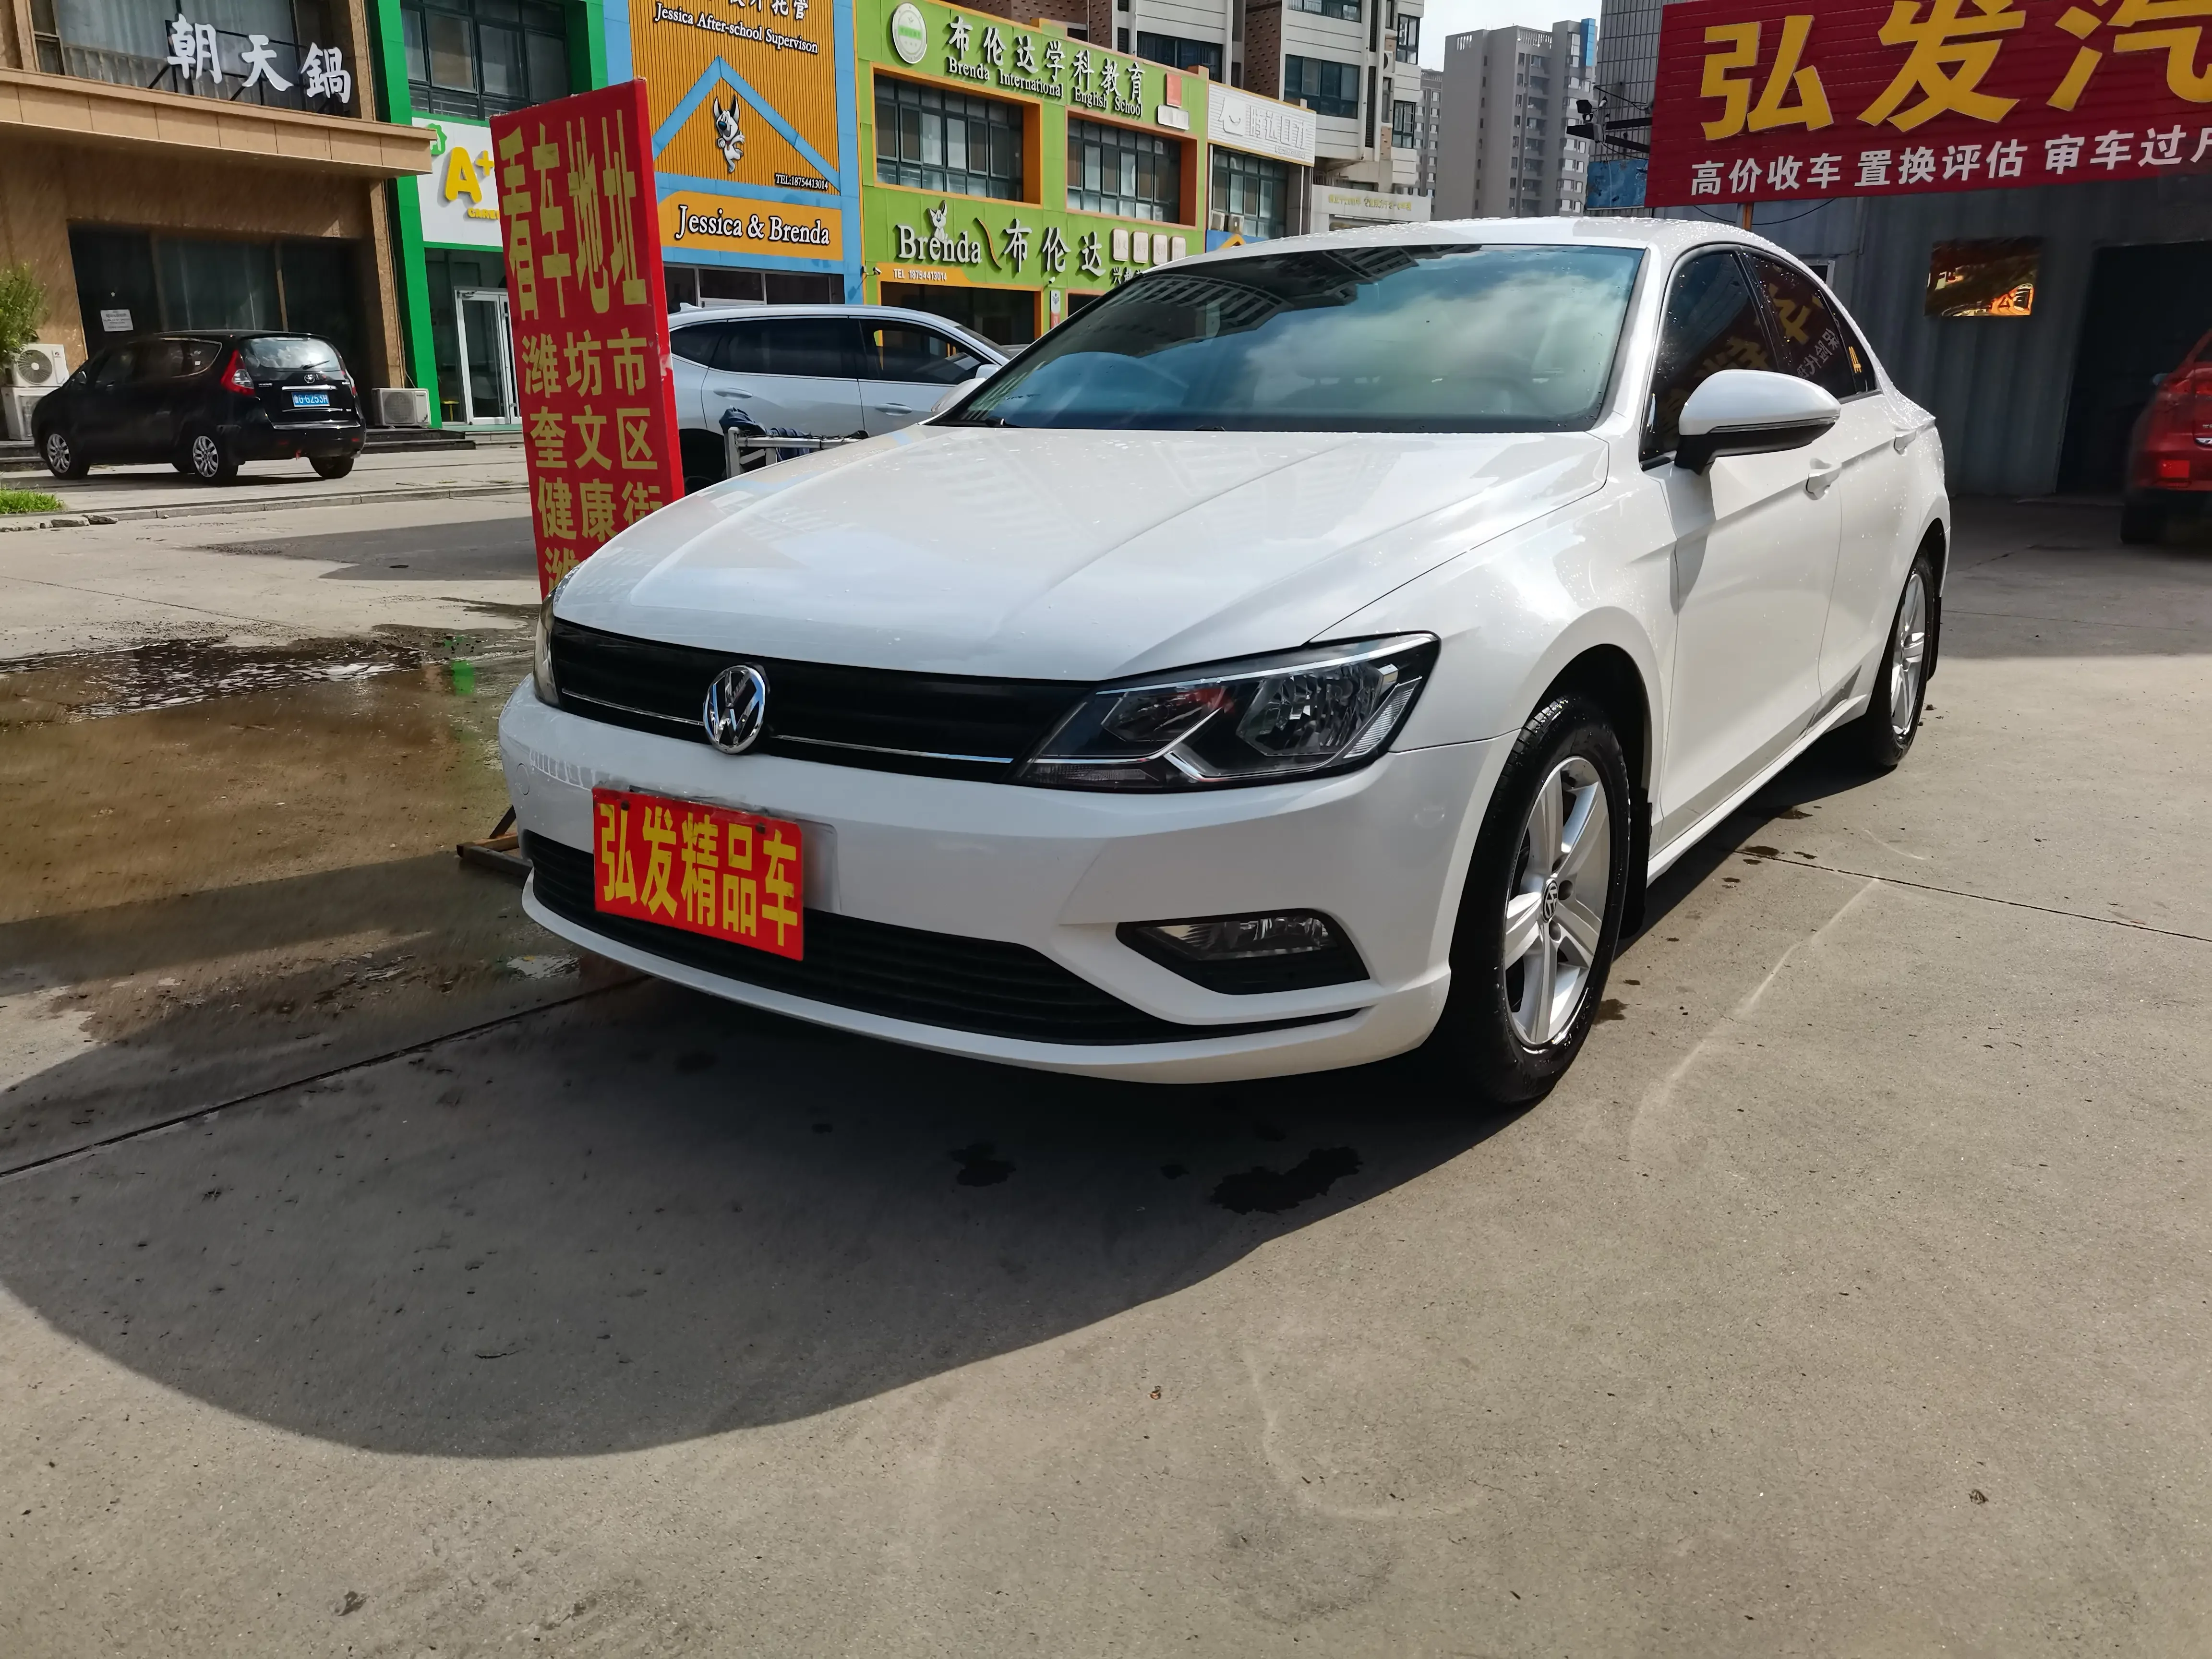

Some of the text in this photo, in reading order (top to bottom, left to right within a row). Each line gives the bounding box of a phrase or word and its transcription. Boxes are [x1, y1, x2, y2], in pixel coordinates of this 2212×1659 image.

[167, 13, 352, 103] 朝天鍋
[655, 3, 818, 53] Jessica After-school Supervison
[947, 56, 1143, 117] Brenda International English School
[949, 16, 1146, 104] 布伦达学科教育
[1701, 0, 2212, 140] 弘发汽
[445, 146, 495, 203] A+
[1691, 154, 1843, 196] 高价收车
[1854, 139, 2028, 187] 置换评估
[499, 109, 647, 321] 看车地址
[675, 204, 831, 245] Jessica & Brenda
[897, 224, 983, 264] Brenda
[893, 268, 905, 279] TEL
[1003, 218, 1106, 277] 布伦达
[522, 328, 647, 398] 潍坊市
[529, 404, 658, 470] 奎文区
[600, 803, 798, 947] 弘发精品车
